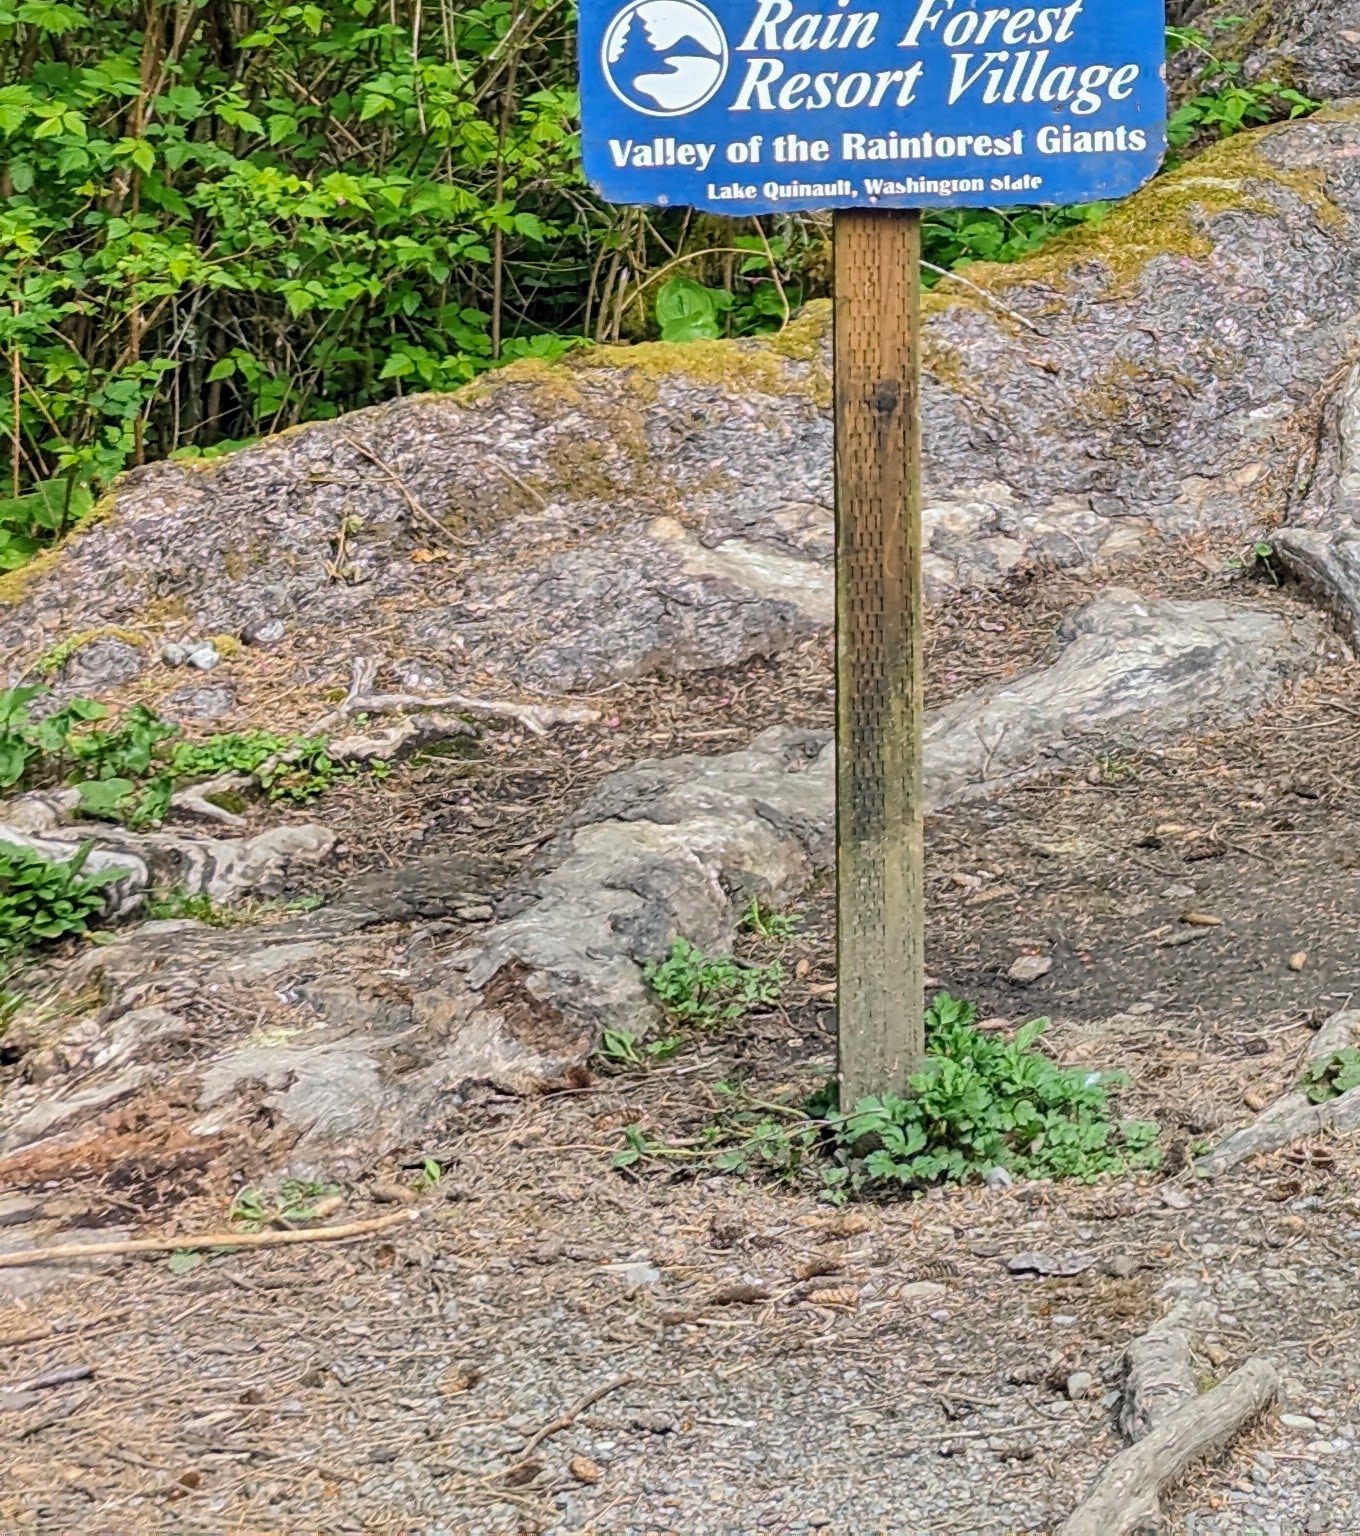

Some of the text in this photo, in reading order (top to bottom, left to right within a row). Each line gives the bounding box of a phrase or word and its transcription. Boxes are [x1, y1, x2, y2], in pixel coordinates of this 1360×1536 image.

[727, 49, 1140, 115] Resort Village
[608, 124, 1147, 172] Valley of the Rainforest Giants
[707, 182, 758, 200] Lake
[762, 179, 859, 202] Quinault,
[863, 175, 985, 197] Washington
